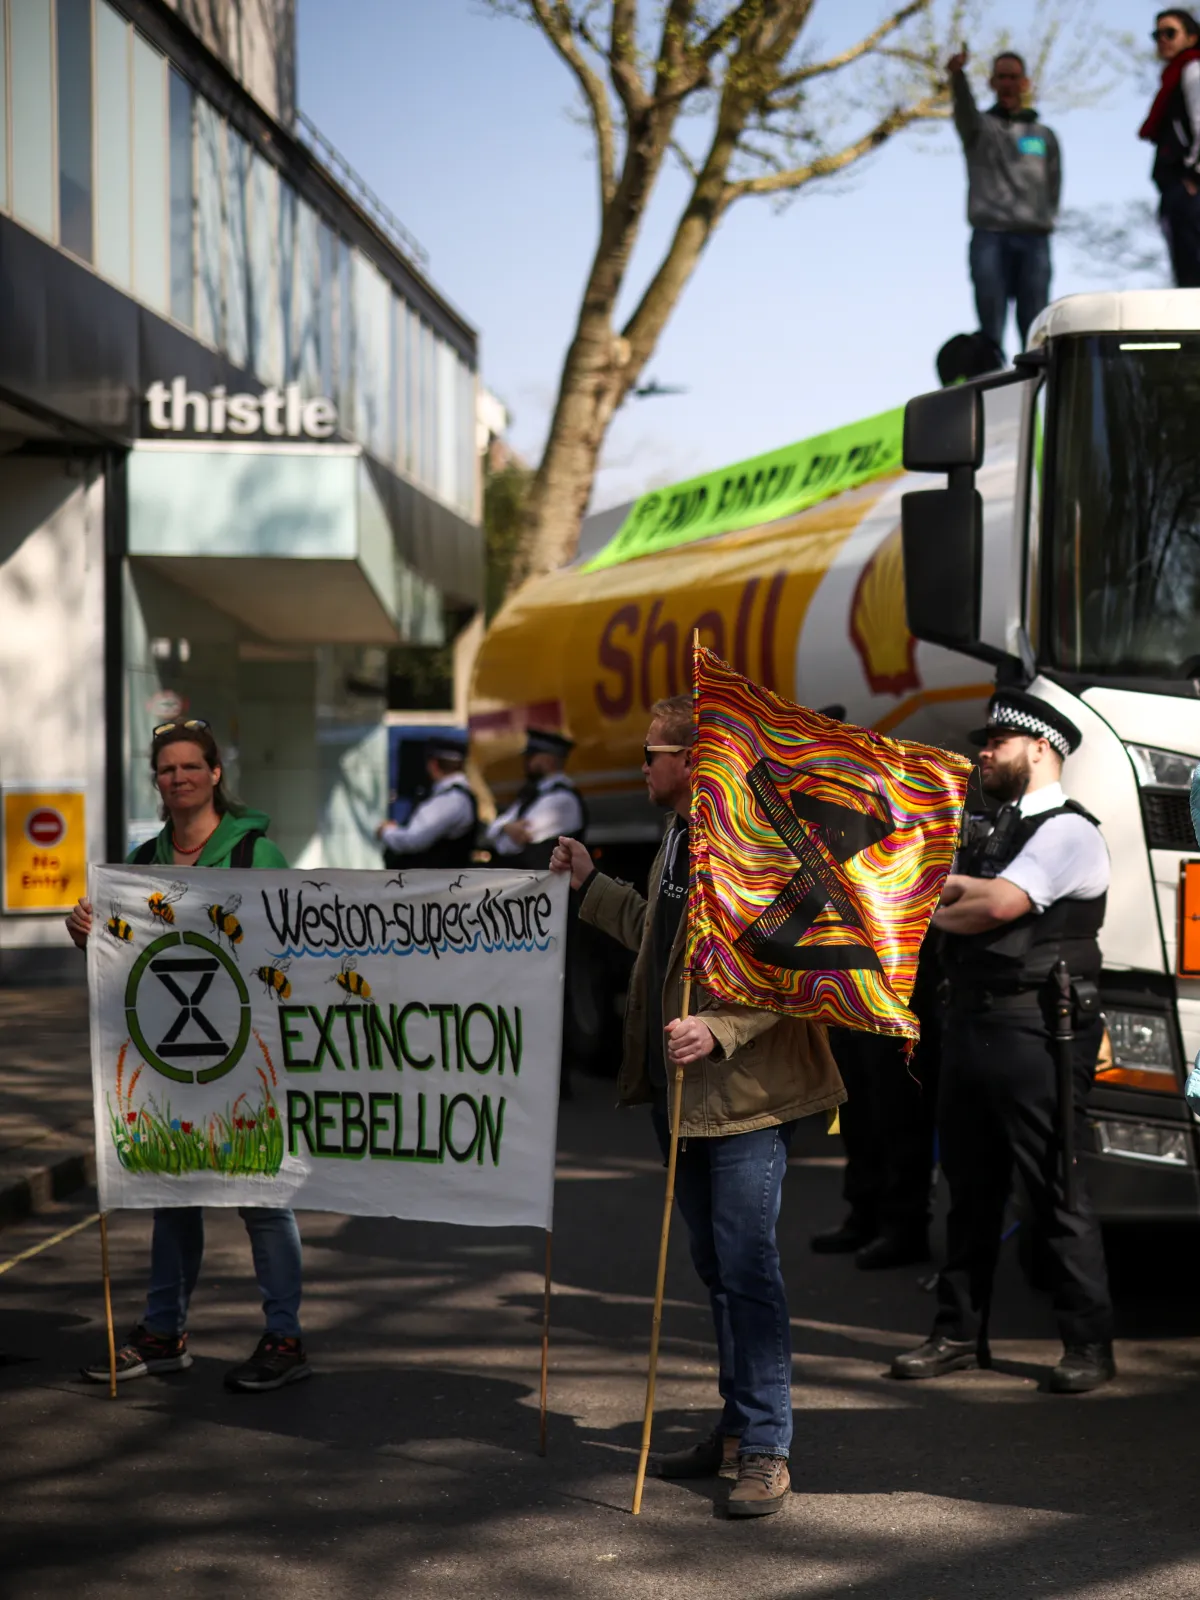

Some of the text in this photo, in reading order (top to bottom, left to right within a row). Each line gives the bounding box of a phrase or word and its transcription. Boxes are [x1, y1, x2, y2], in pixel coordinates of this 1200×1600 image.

[145, 375, 338, 438] thistle
[22, 873, 70, 891] Entry
[32, 855, 60, 870] No
[278, 1001, 523, 1075] EXTINCTION
[285, 1089, 507, 1165] REBELLION
